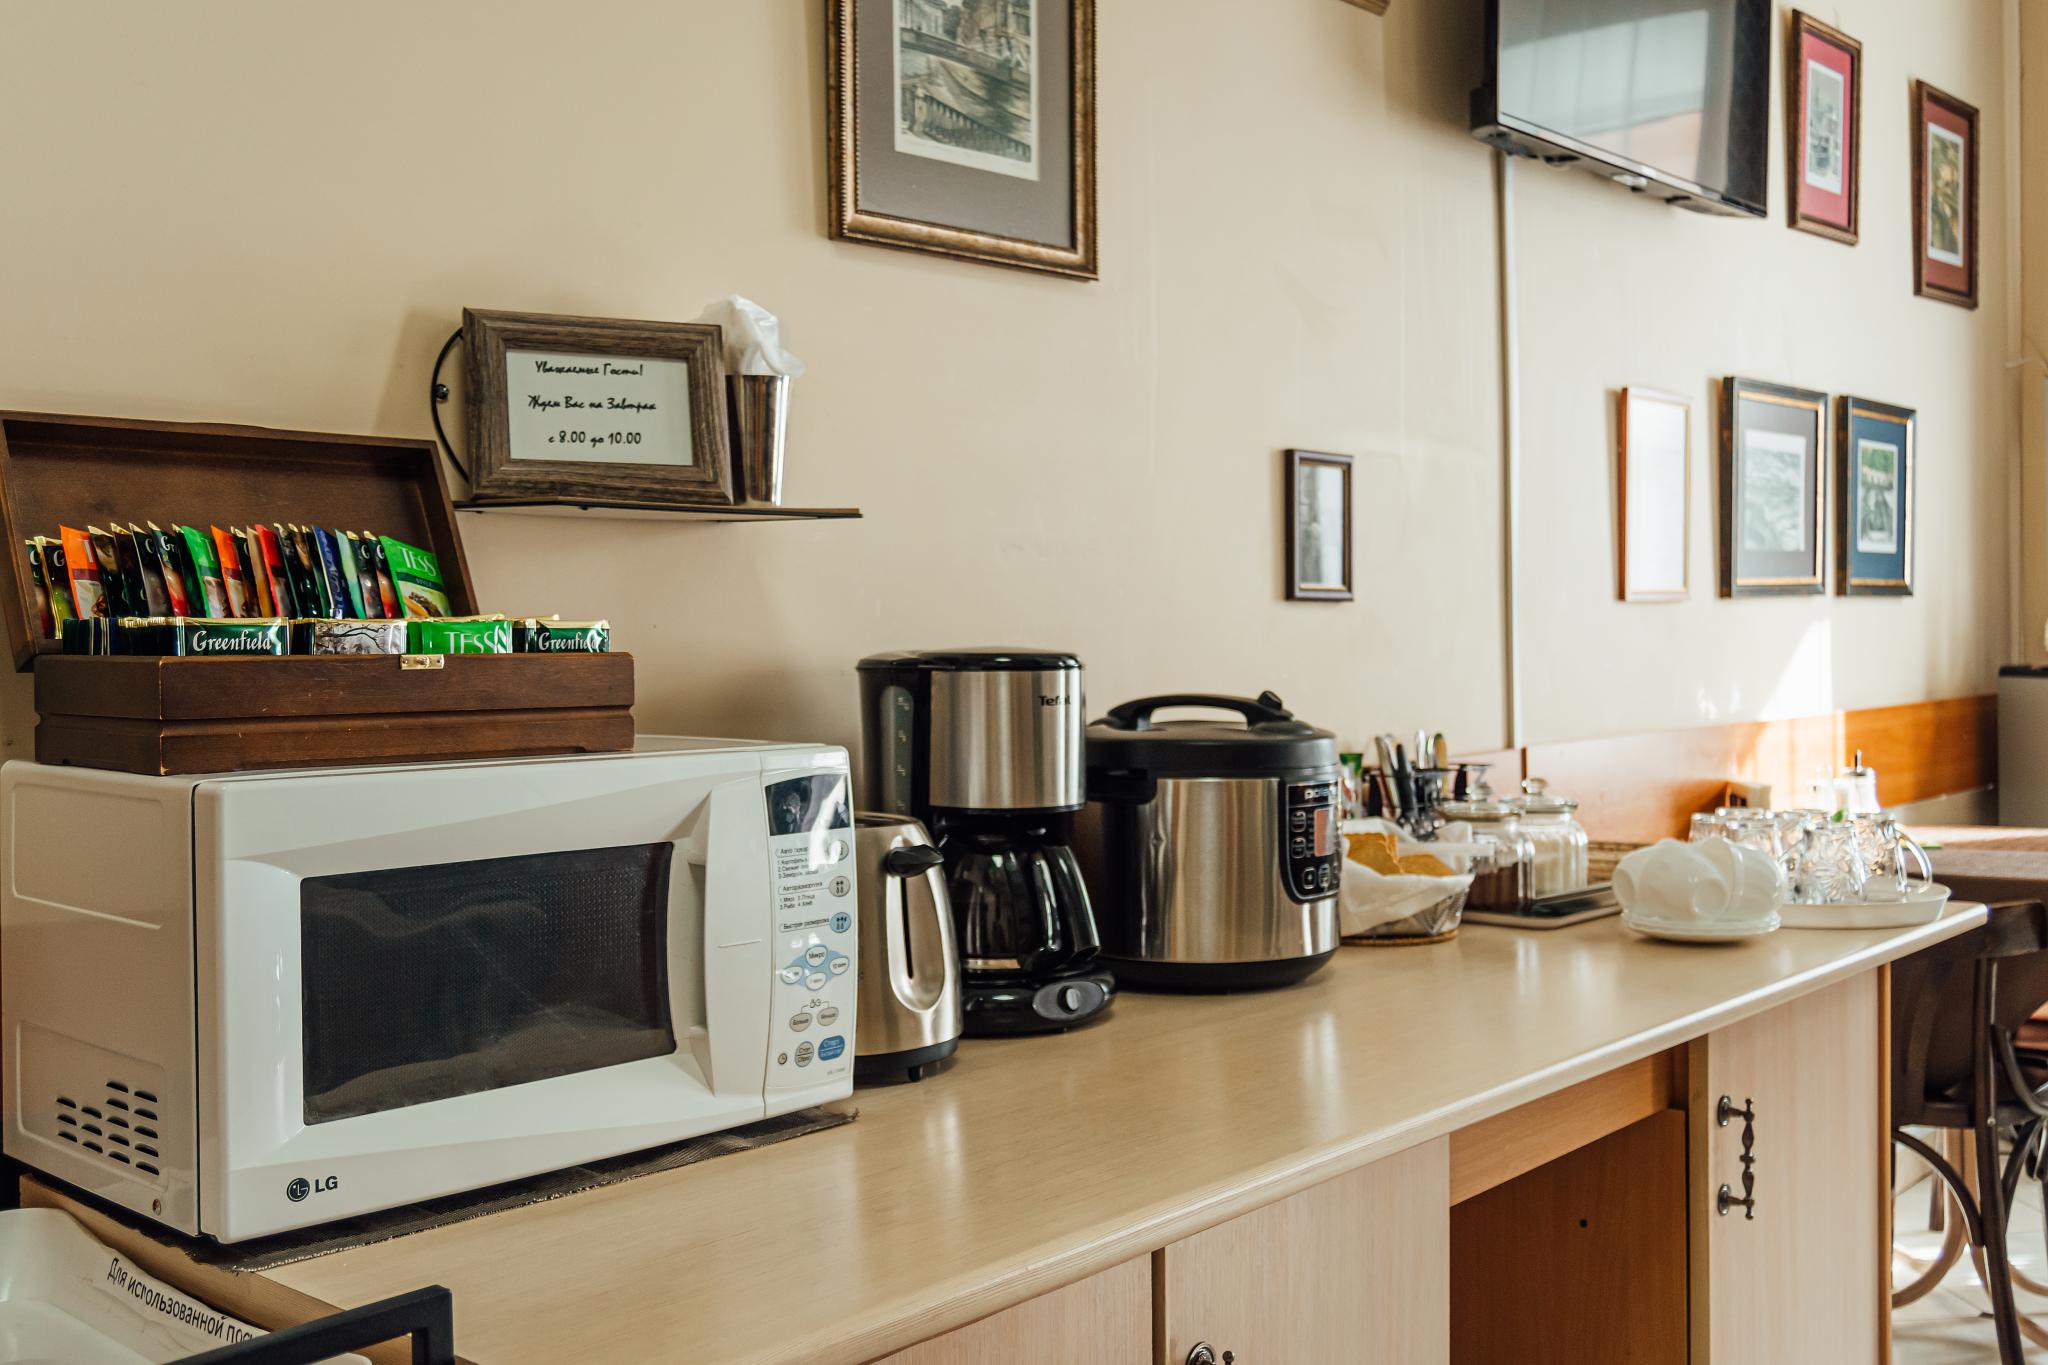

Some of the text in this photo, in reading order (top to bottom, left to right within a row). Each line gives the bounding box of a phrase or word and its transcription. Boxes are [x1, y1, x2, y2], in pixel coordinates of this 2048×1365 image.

[535, 360, 643, 376] Уважаемые Гости!
[564, 396, 585, 408] Вас
[589, 401, 603, 409] на
[607, 397, 656, 413] Завтрак
[559, 430, 586, 444] 8.00
[590, 436, 604, 448] до
[608, 431, 642, 445] 10.00
[398, 545, 436, 576] TESS
[192, 629, 272, 652] Greenfield
[538, 631, 600, 651] Greenfied
[315, 1176, 338, 1193] LG
[107, 1257, 128, 1288] Для
